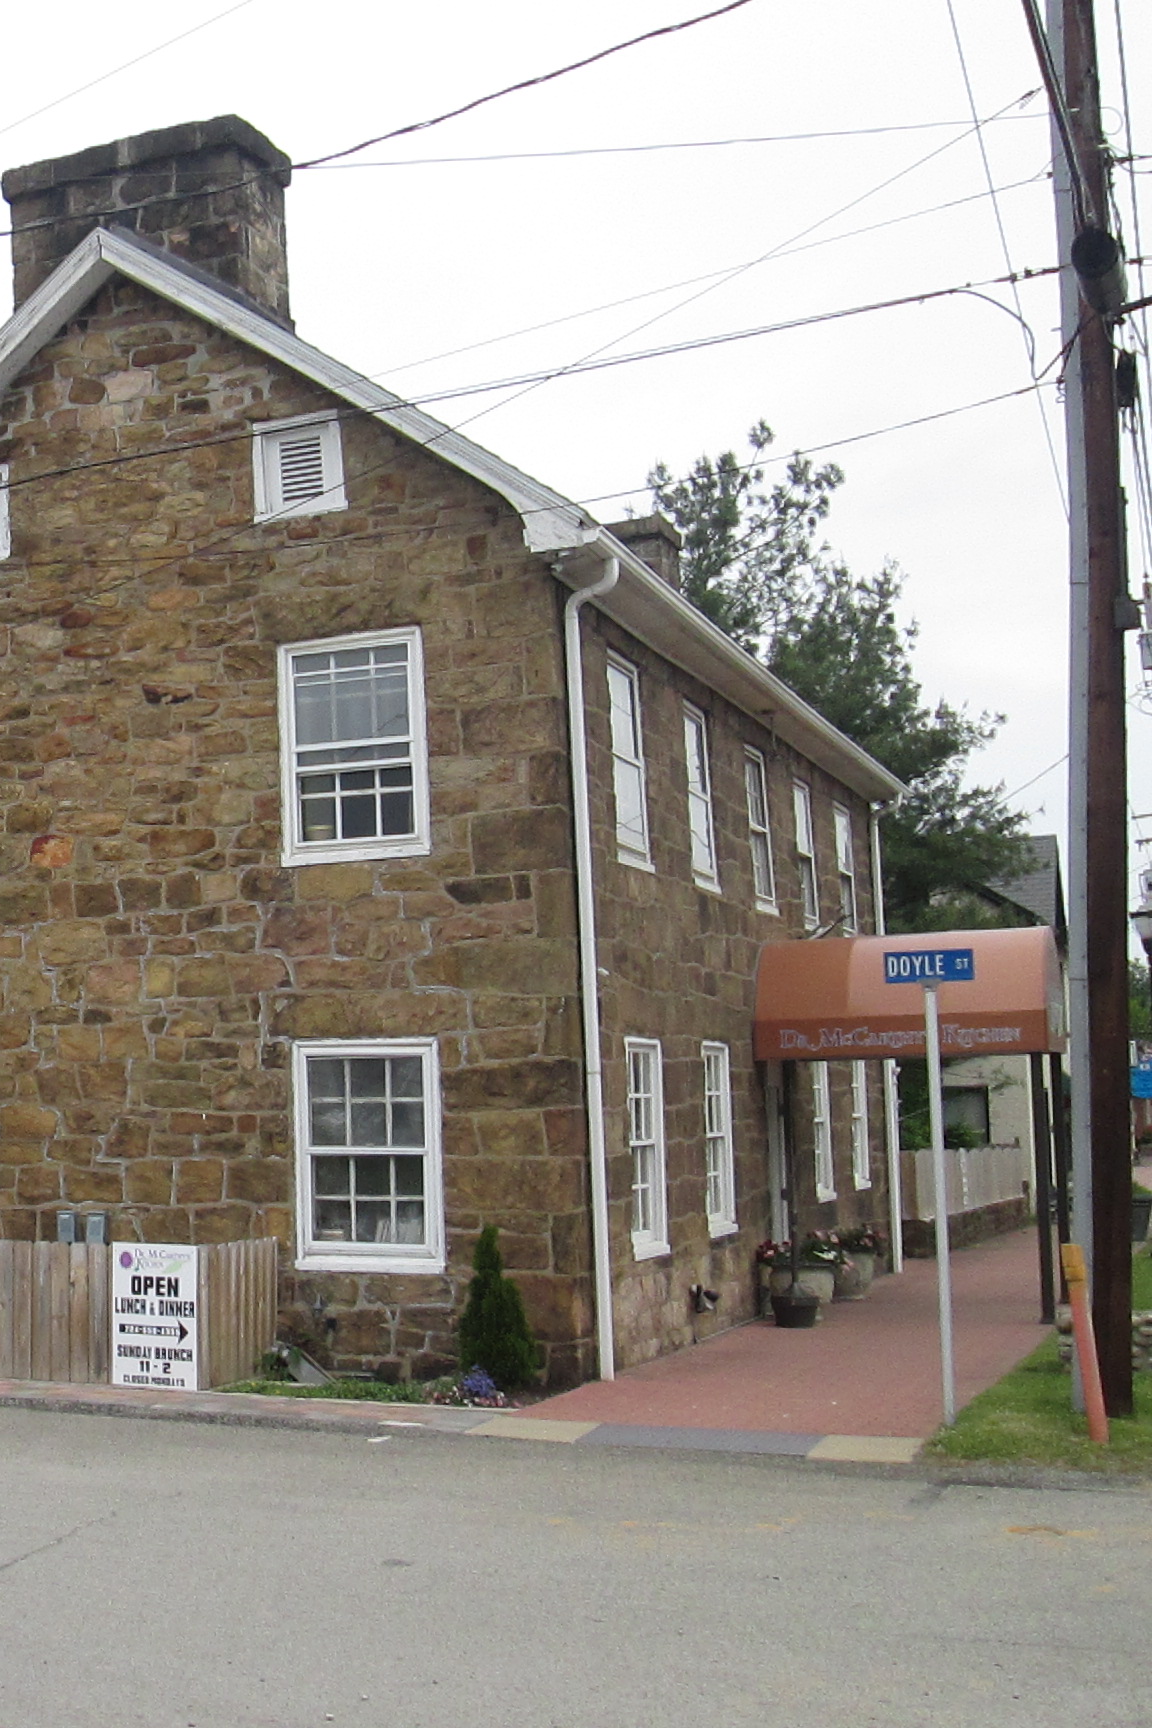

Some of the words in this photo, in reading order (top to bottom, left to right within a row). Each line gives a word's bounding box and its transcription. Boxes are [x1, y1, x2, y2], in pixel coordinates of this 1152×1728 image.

[887, 954, 945, 978] DOYLE
[955, 958, 969, 970] ST
[131, 1275, 179, 1297] OPEN
[115, 1297, 146, 1315] LUNCH
[159, 1300, 195, 1318] DINNER
[117, 1344, 152, 1359] SUNDAY
[154, 1347, 193, 1362] BRUNCH
[139, 1362, 150, 1373] 11
[162, 1363, 171, 1375] 2
